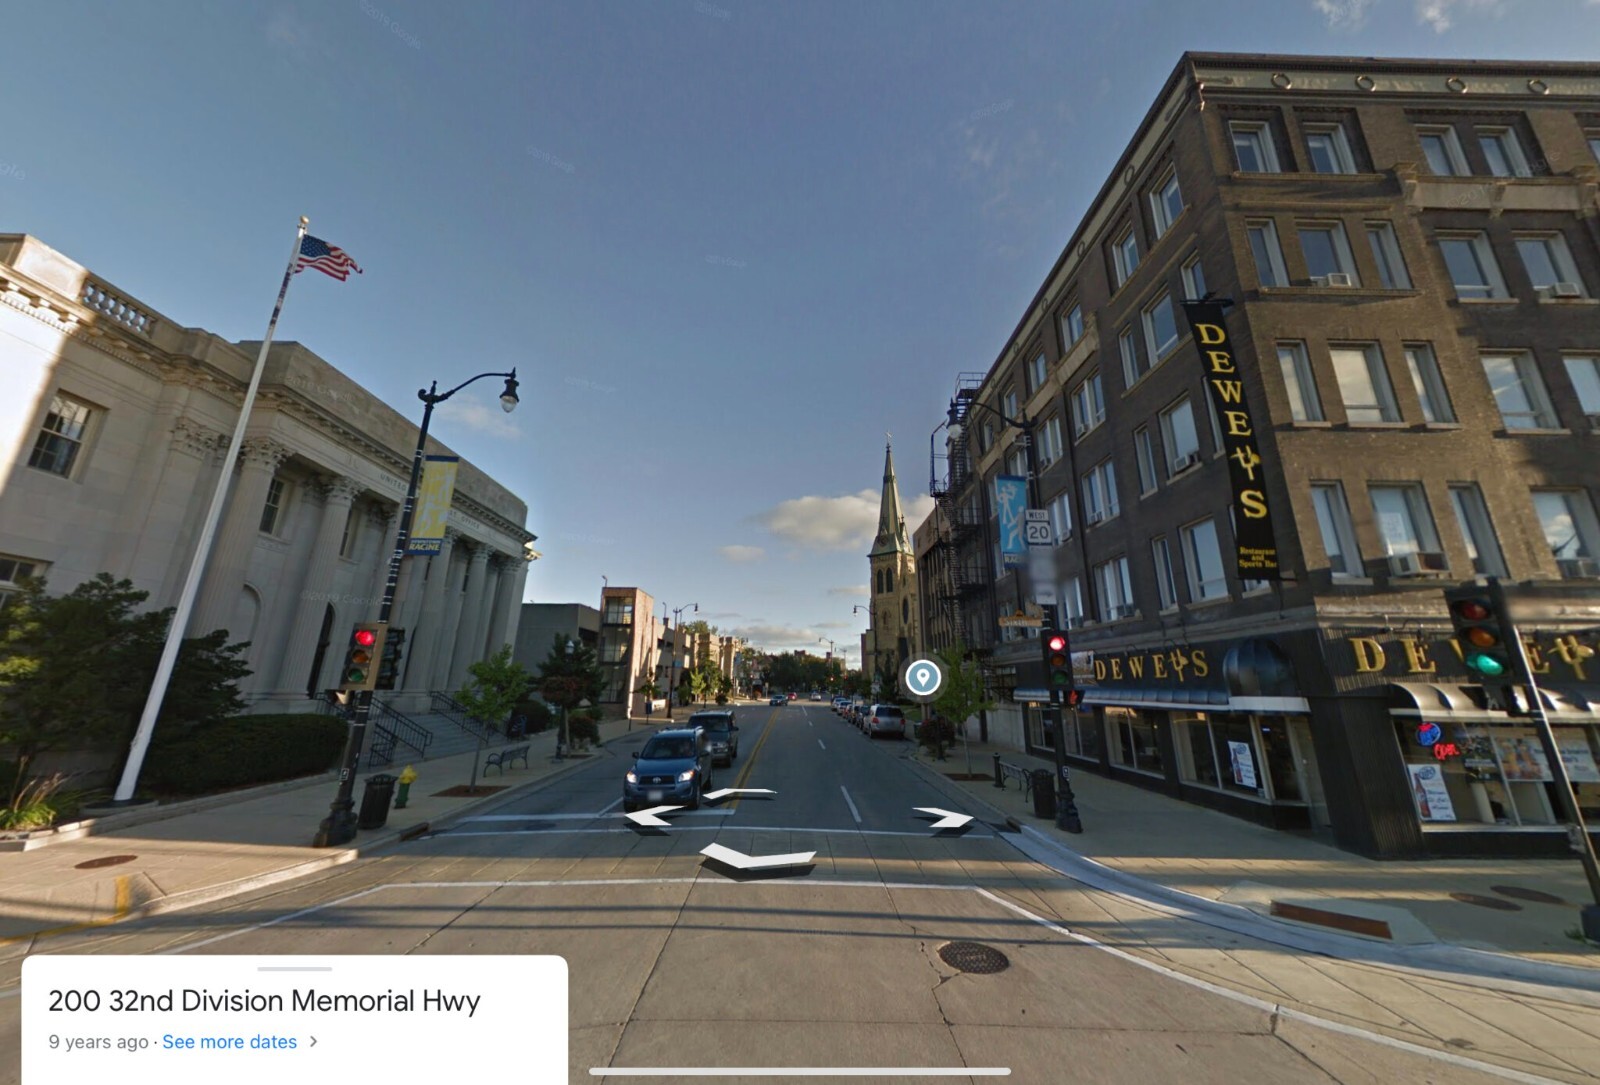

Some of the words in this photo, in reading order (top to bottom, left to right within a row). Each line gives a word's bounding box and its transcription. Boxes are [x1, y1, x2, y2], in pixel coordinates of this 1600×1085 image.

[380, 472, 408, 491] UNITED
[461, 515, 481, 530] OFFICE
[1028, 511, 1046, 520] WEST
[1029, 526, 1049, 540] 20
[408, 543, 440, 551] RACINE
[1239, 559, 1263, 569] Sports
[1265, 560, 1278, 568] Bar
